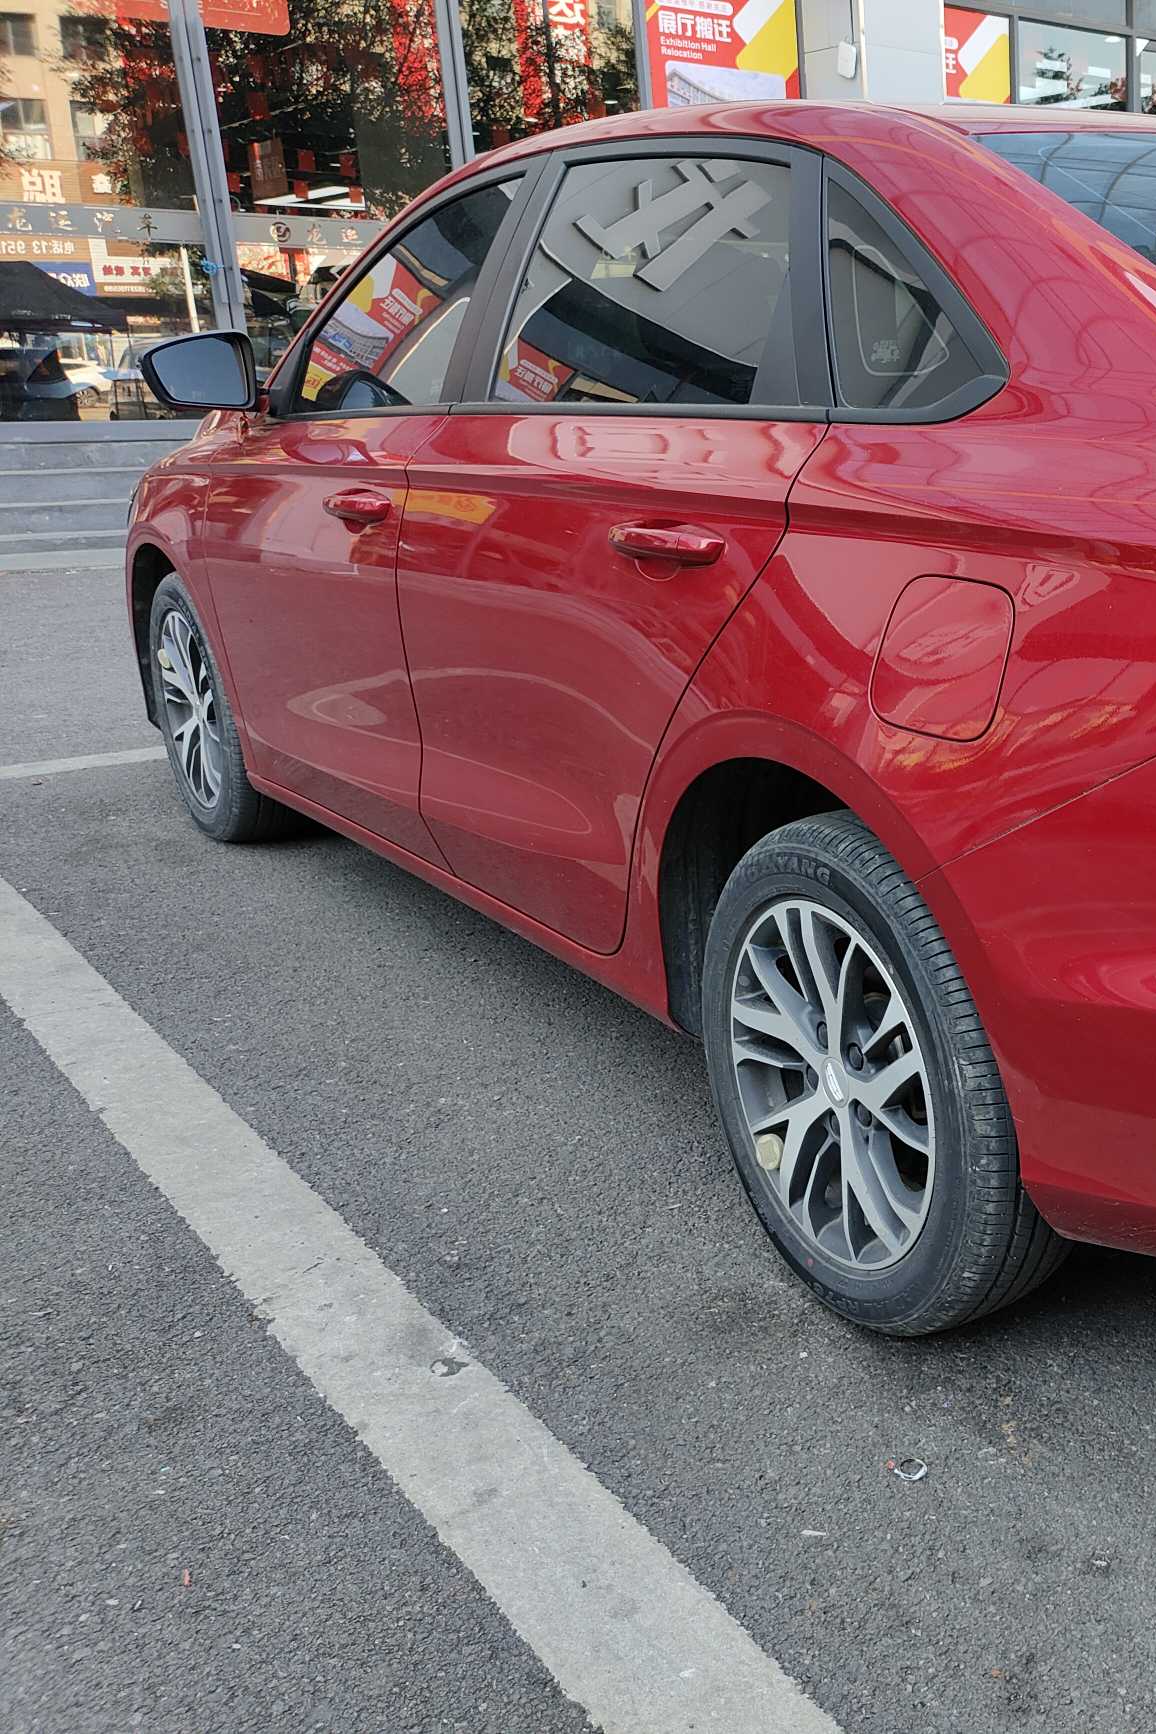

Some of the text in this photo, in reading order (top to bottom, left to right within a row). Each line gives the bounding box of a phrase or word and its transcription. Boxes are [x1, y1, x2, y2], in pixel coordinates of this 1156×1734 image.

[657, 10, 732, 43] 展厅搬迁
[660, 36, 717, 52] Exhibition Hall
[660, 46, 703, 60] Relocation
